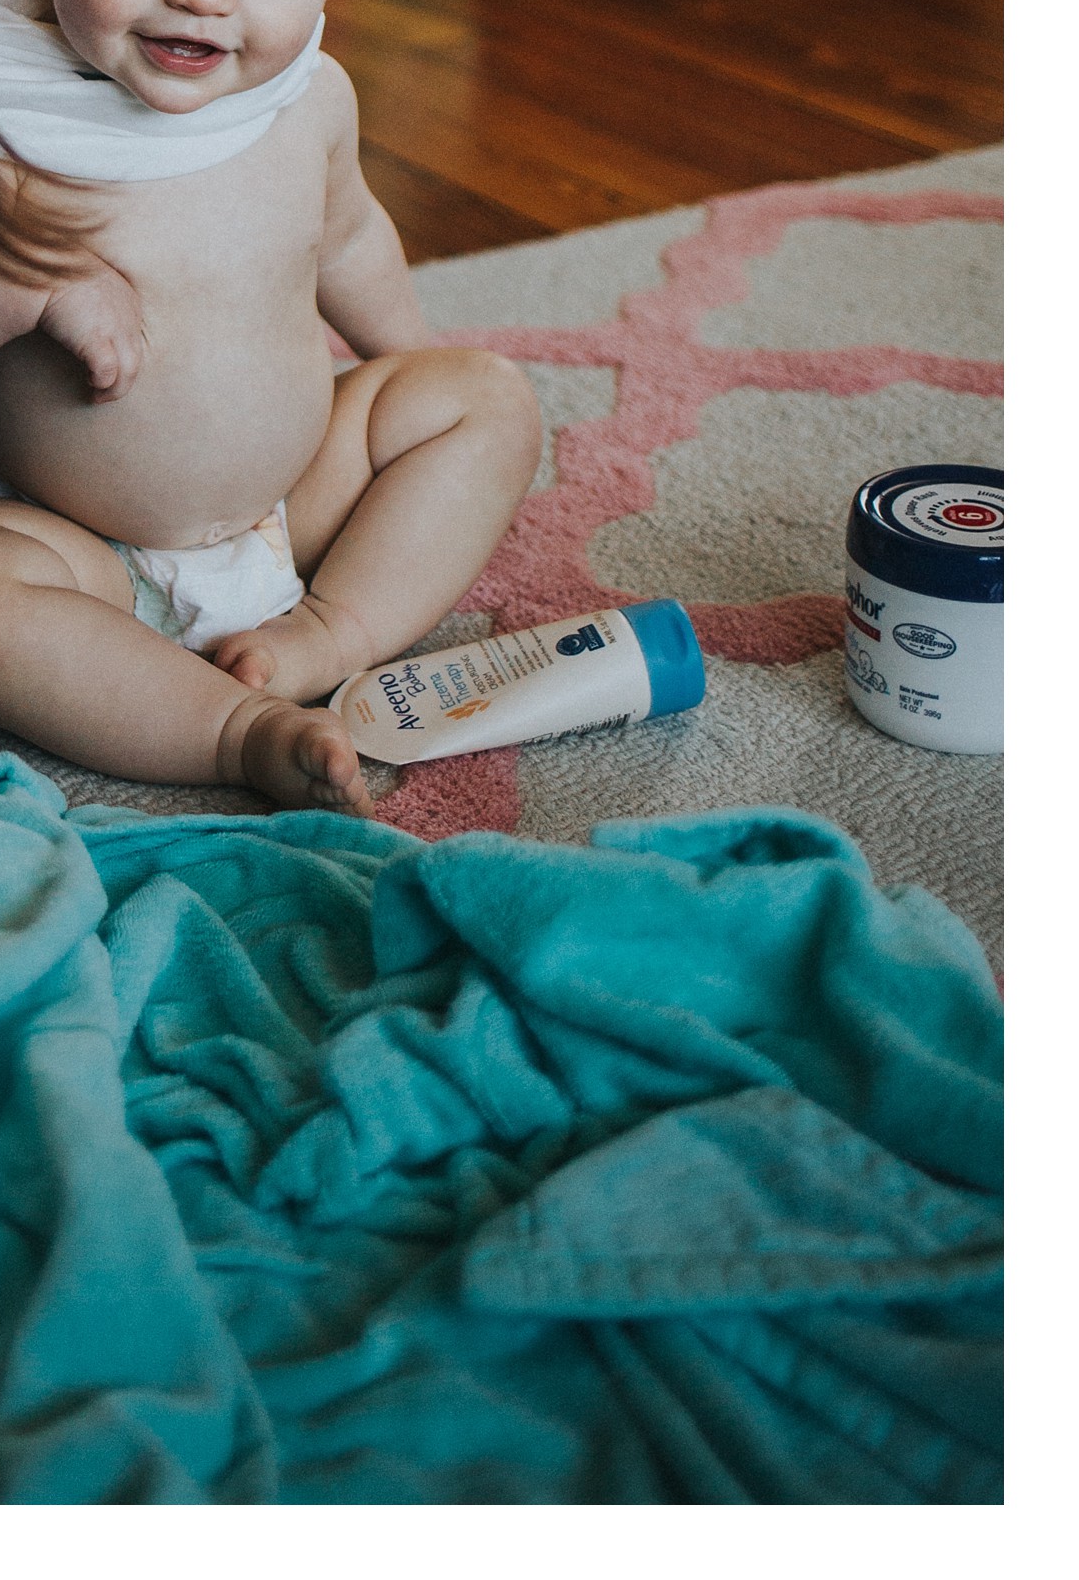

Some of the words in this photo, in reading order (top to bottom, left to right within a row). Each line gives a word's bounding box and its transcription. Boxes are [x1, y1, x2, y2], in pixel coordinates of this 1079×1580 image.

[913, 490, 939, 501] Rash
[910, 516, 947, 536] Relieves
[895, 631, 953, 650] HOUSEKEEPING
[910, 630, 935, 641] GOOD
[399, 663, 427, 698] Baby
[444, 663, 472, 704] Therapy
[483, 671, 499, 690] CREAM
[430, 672, 456, 710] Eczema
[378, 673, 425, 730] Aveeno
